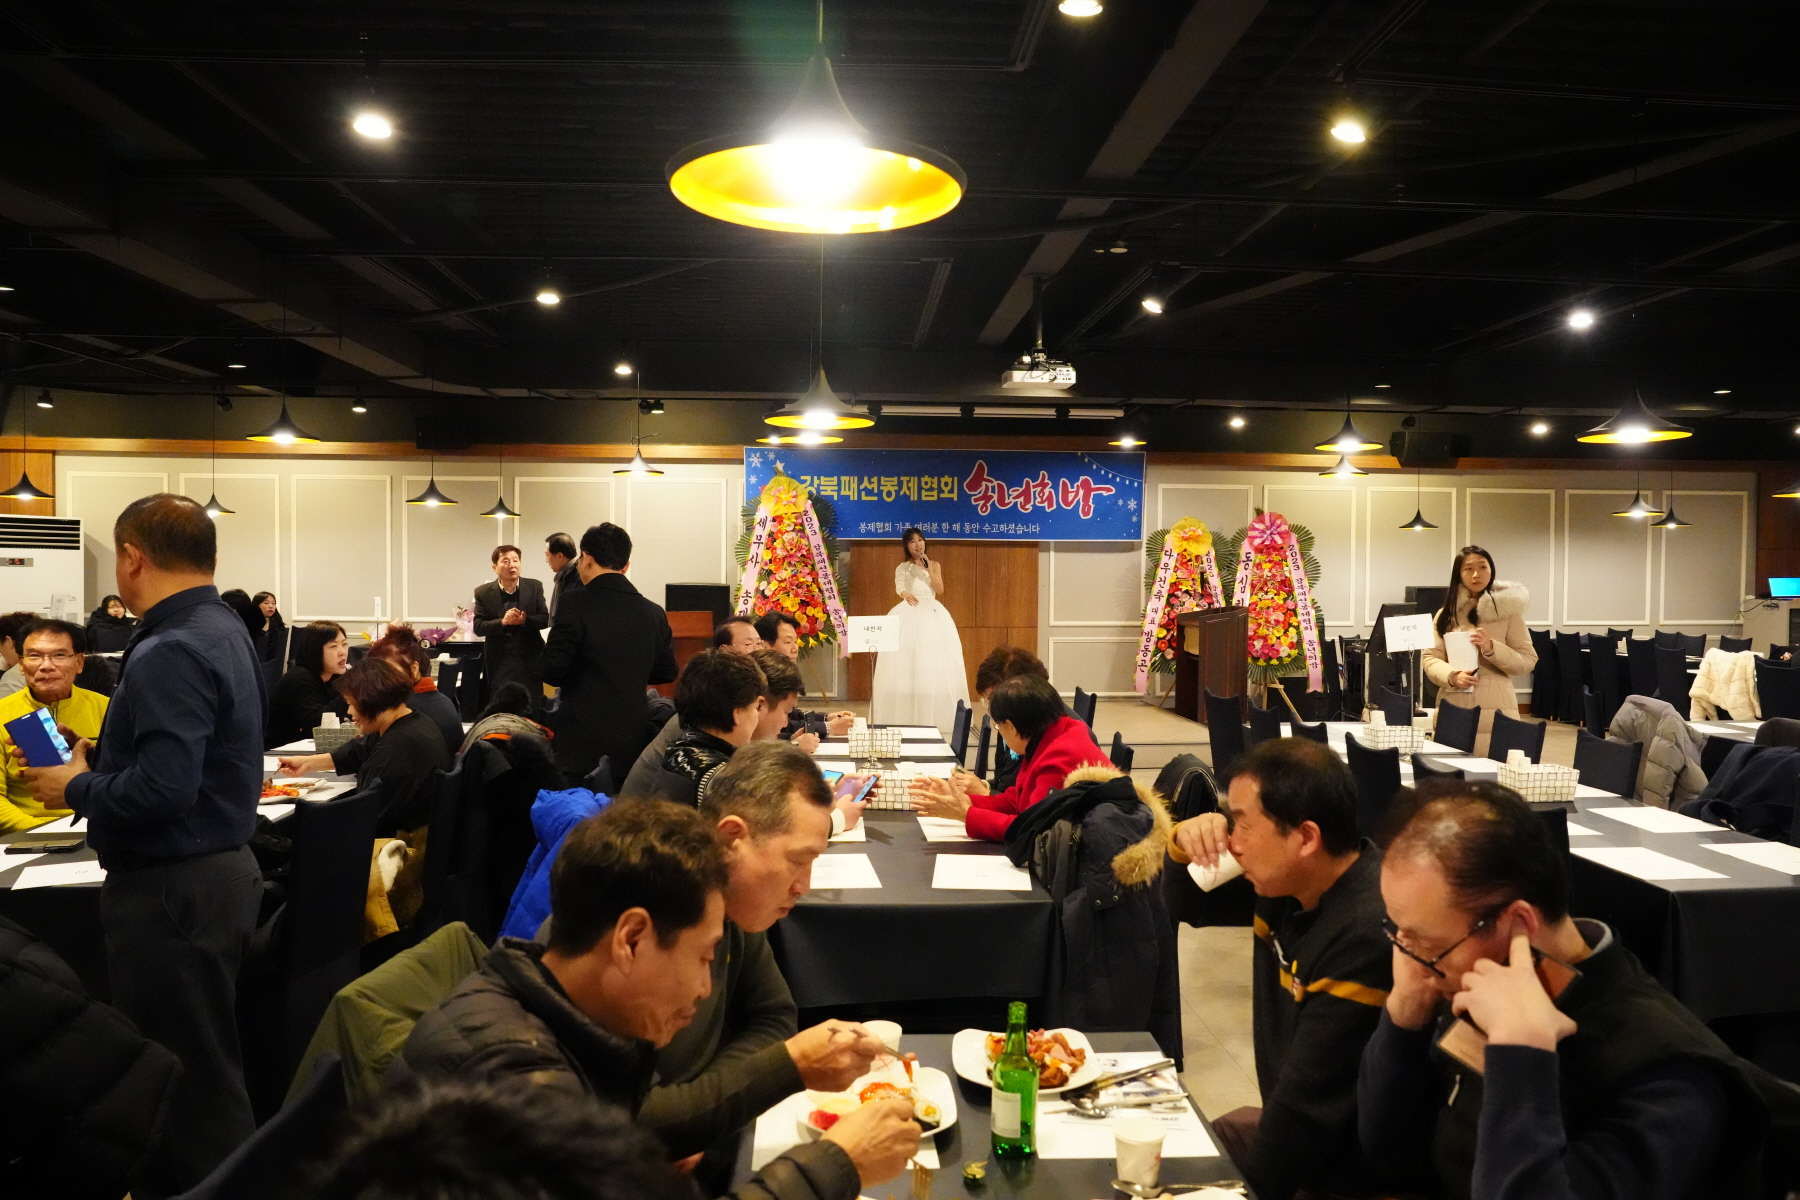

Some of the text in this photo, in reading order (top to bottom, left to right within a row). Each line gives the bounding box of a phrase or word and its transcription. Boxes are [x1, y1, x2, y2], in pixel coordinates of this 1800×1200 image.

[800, 474, 958, 502] 강북패션봉제협회
[802, 509, 818, 536] 2023
[858, 521, 892, 534] 봉제협회
[914, 521, 940, 534] 여러분
[941, 522, 950, 534] 한
[952, 522, 961, 533] 해
[963, 522, 981, 534] 동안
[982, 522, 1041, 535] 수고하셨습니다
[747, 515, 769, 569] 세무사
[1288, 544, 1301, 571] 2023
[1147, 606, 1160, 625] 대표
